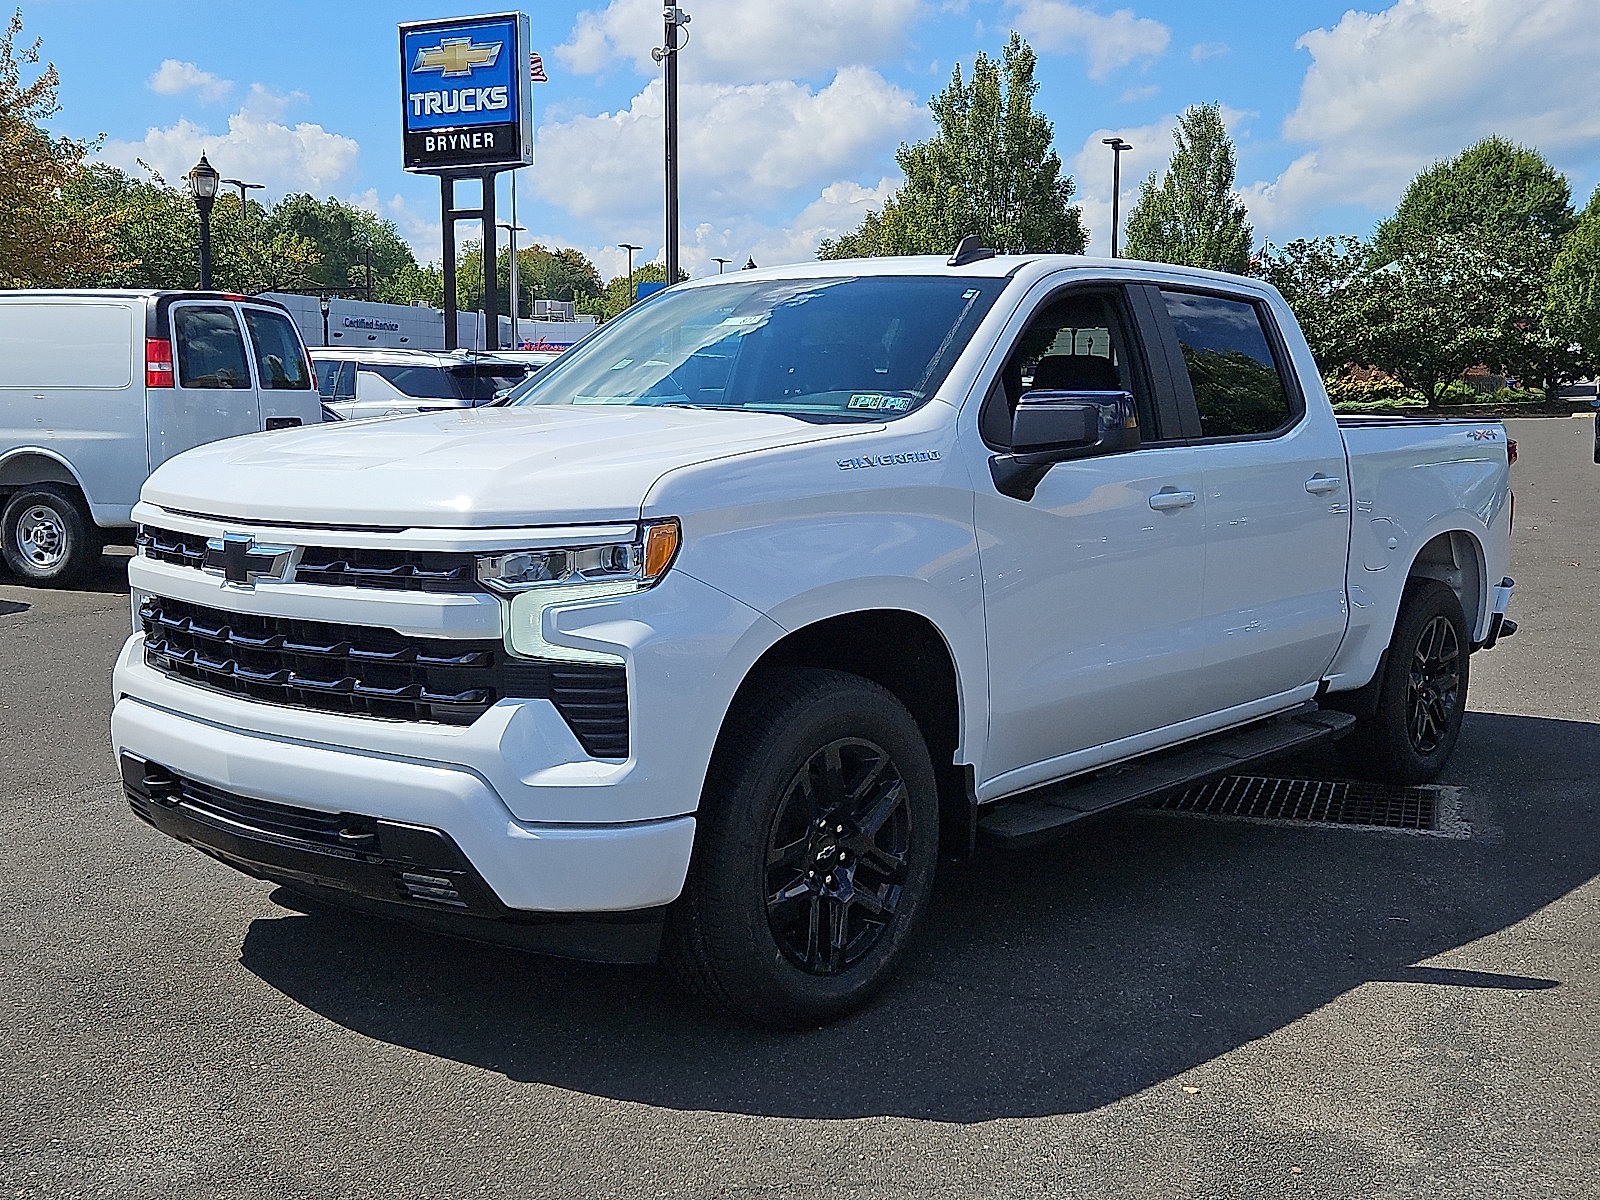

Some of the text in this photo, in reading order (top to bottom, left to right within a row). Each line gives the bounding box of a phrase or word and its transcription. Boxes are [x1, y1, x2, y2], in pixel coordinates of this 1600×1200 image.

[409, 86, 508, 116] TRUCKS
[425, 132, 494, 152] BRYNER
[344, 317, 399, 331] Certified Service
[836, 449, 942, 471] SILVERADO
